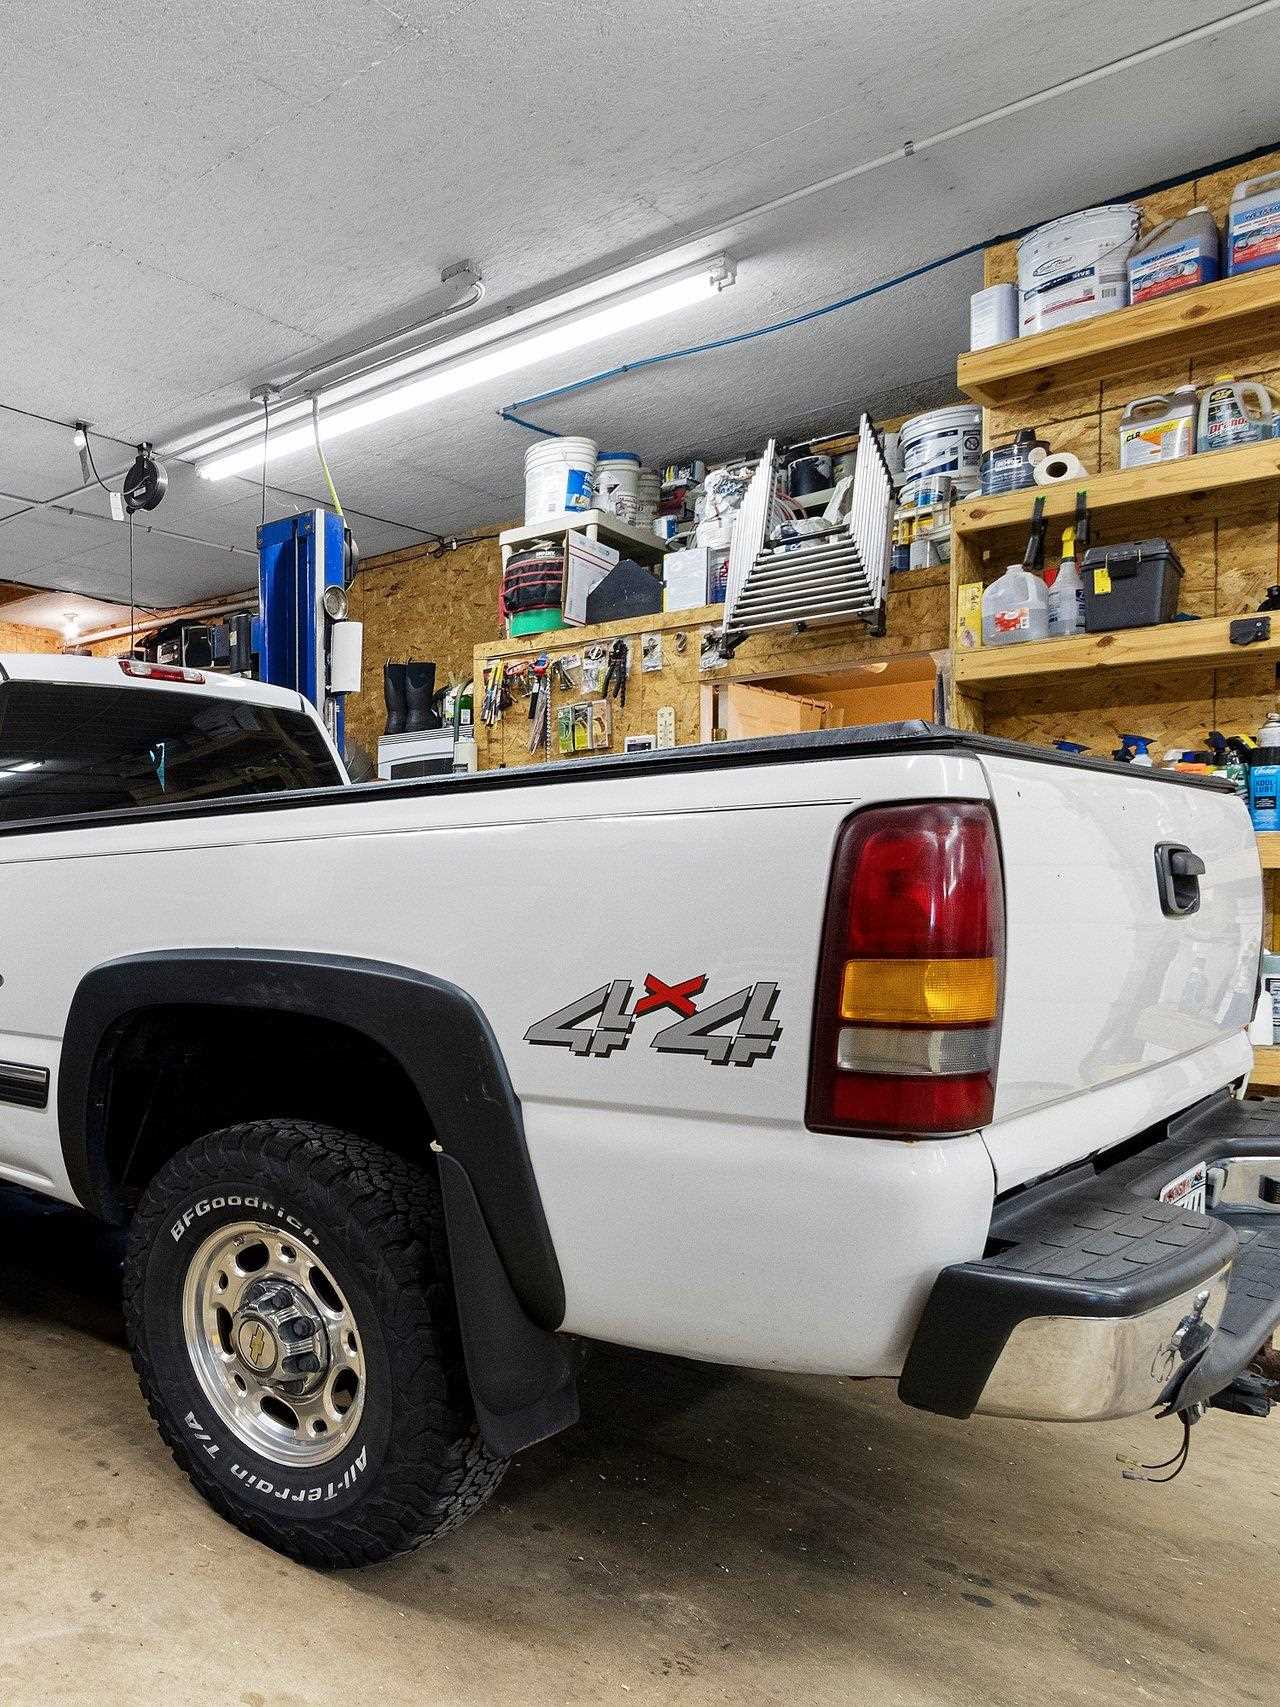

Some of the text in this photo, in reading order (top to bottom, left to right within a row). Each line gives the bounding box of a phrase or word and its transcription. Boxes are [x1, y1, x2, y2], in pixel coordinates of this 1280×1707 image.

[170, 1195, 321, 1246] BFGoodrich
[183, 1410, 369, 1505] All-Terrain T/A
